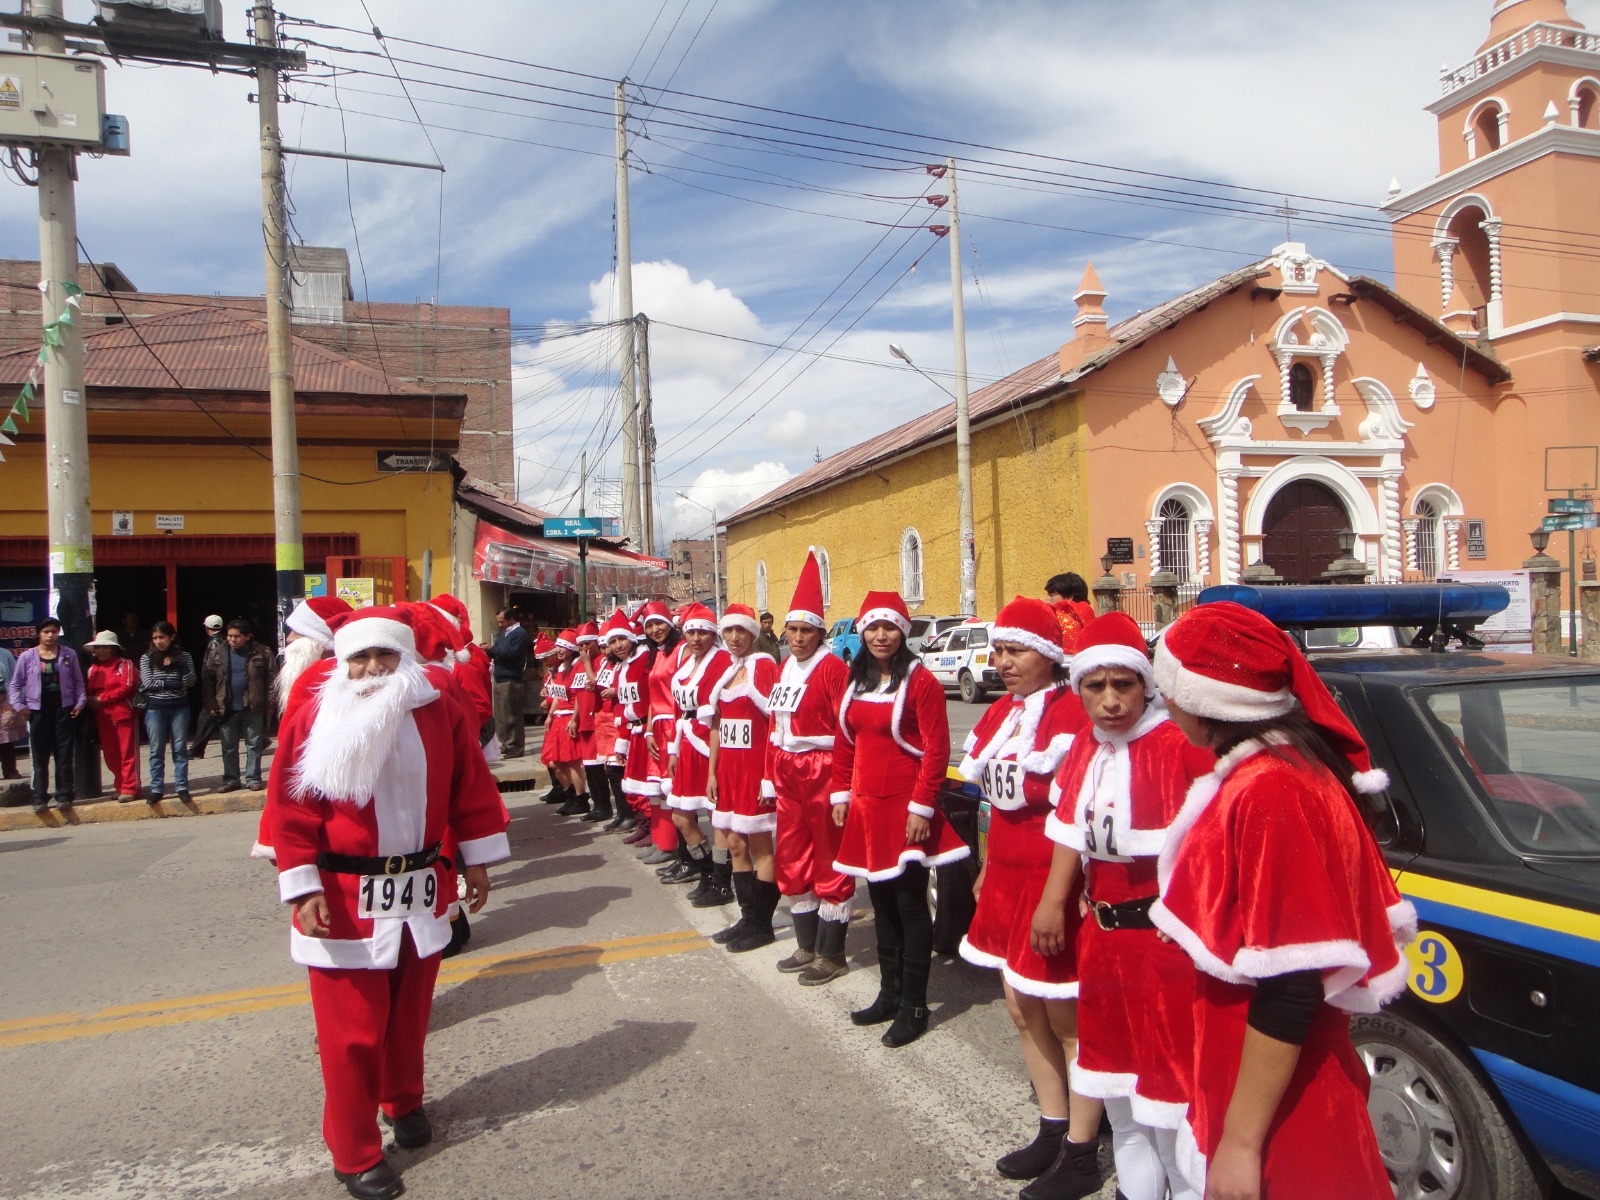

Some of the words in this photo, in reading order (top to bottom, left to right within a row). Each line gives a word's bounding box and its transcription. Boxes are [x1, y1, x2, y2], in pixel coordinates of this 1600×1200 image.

[768, 686, 801, 708] 1951
[362, 873, 436, 912] 1949
[1415, 938, 1448, 997] 3
